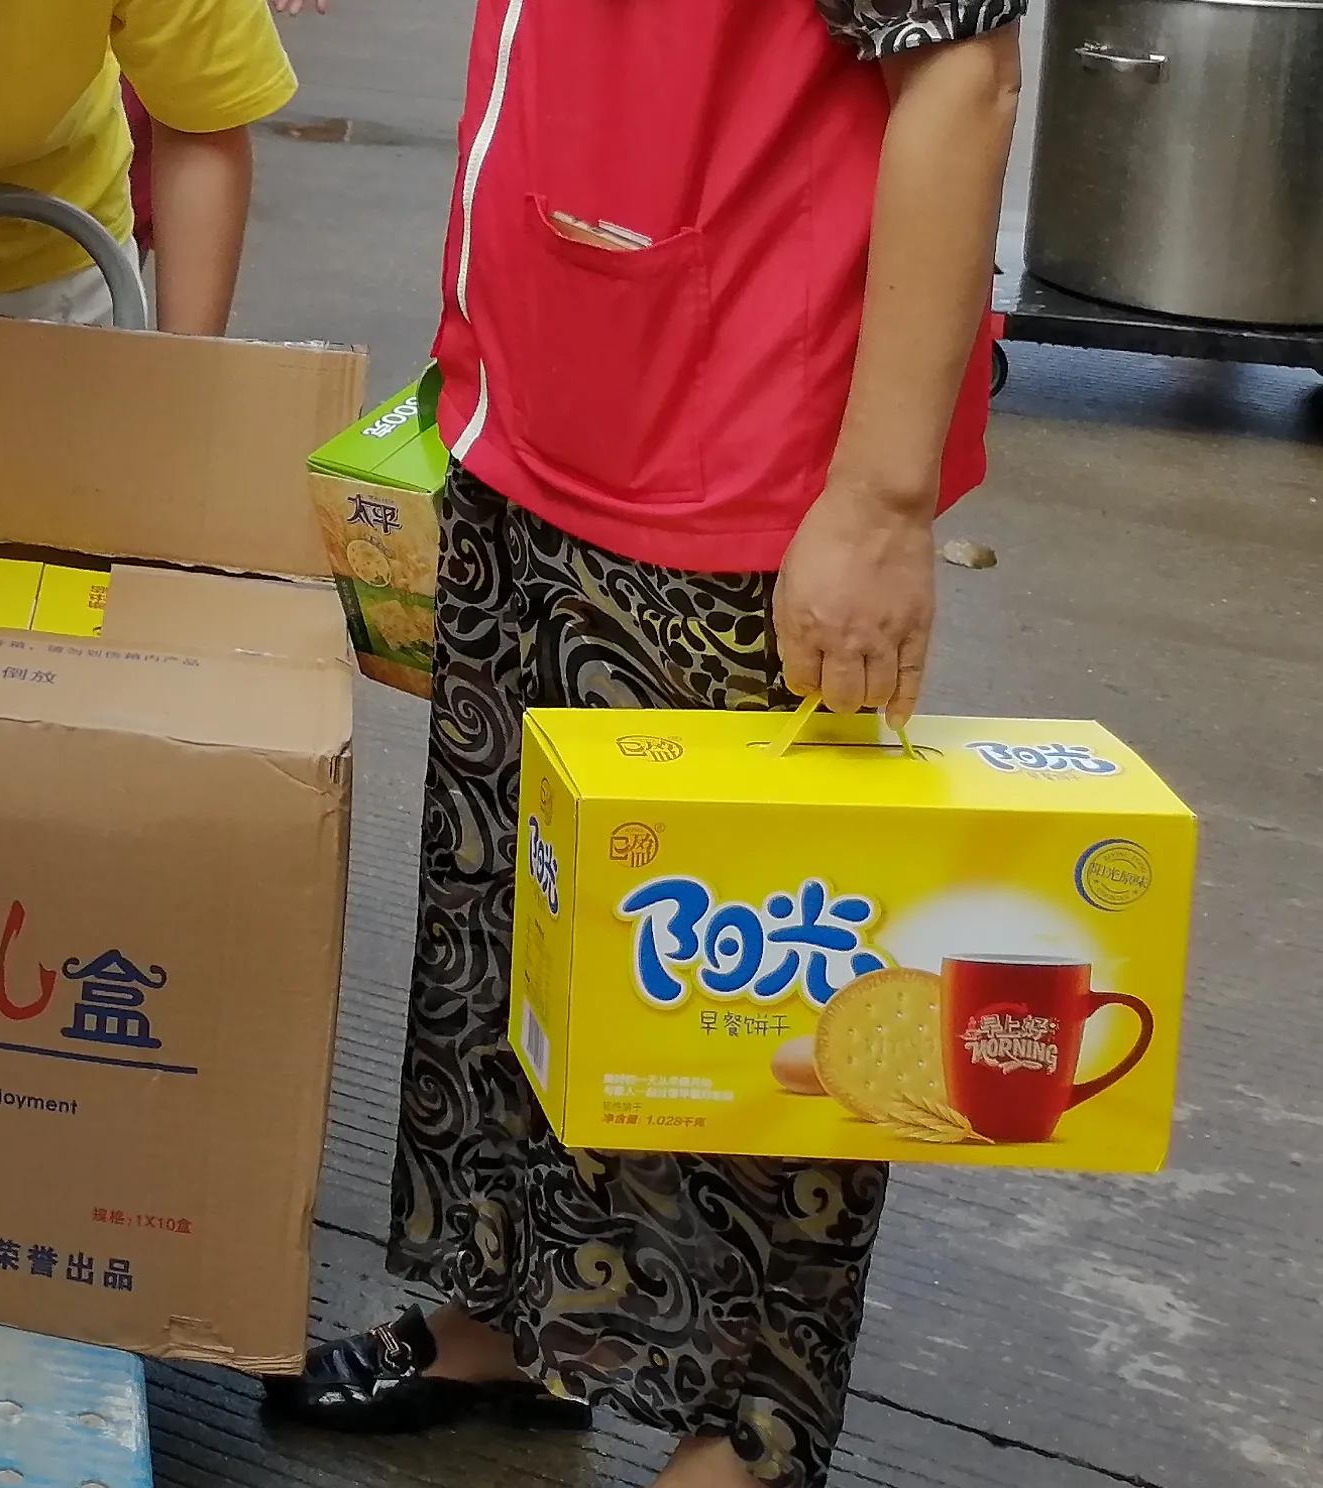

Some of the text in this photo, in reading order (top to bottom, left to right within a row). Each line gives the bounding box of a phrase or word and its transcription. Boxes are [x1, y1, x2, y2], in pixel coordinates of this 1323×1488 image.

[346, 493, 403, 535] 太平
[965, 742, 1117, 774] 阳光
[620, 878, 887, 1003] 阳光
[699, 1010, 792, 1038] 早餐饼干
[980, 1013, 1050, 1040] 早上好
[965, 1037, 1059, 1075] MORNING
